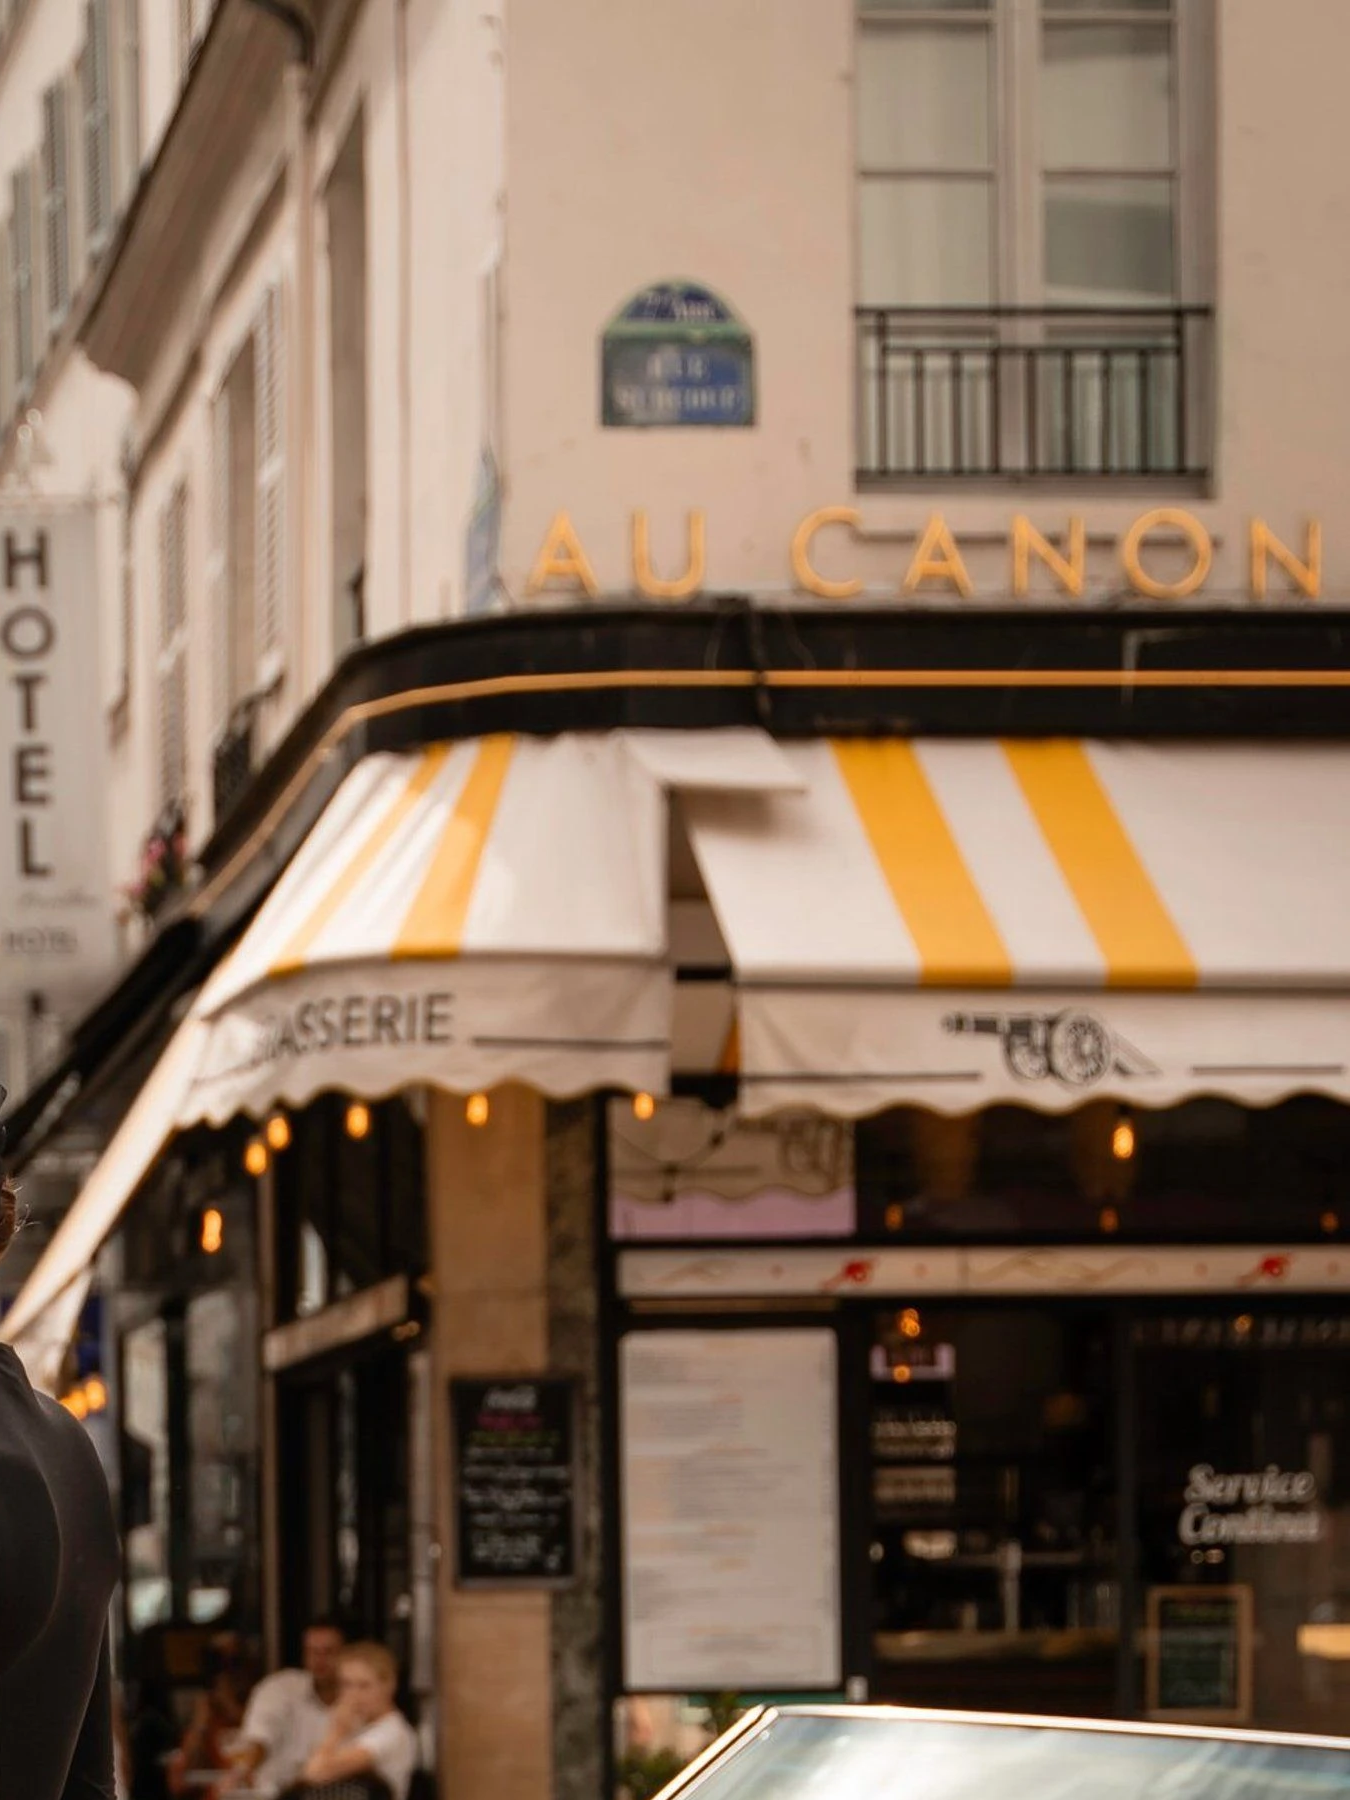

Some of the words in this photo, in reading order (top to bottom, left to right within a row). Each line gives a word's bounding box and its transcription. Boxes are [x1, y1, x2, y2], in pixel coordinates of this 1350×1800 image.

[527, 508, 706, 597] AU
[789, 506, 1322, 600] CANON
[0, 528, 55, 880] HOTEL
[1184, 1462, 1315, 1503] Service
